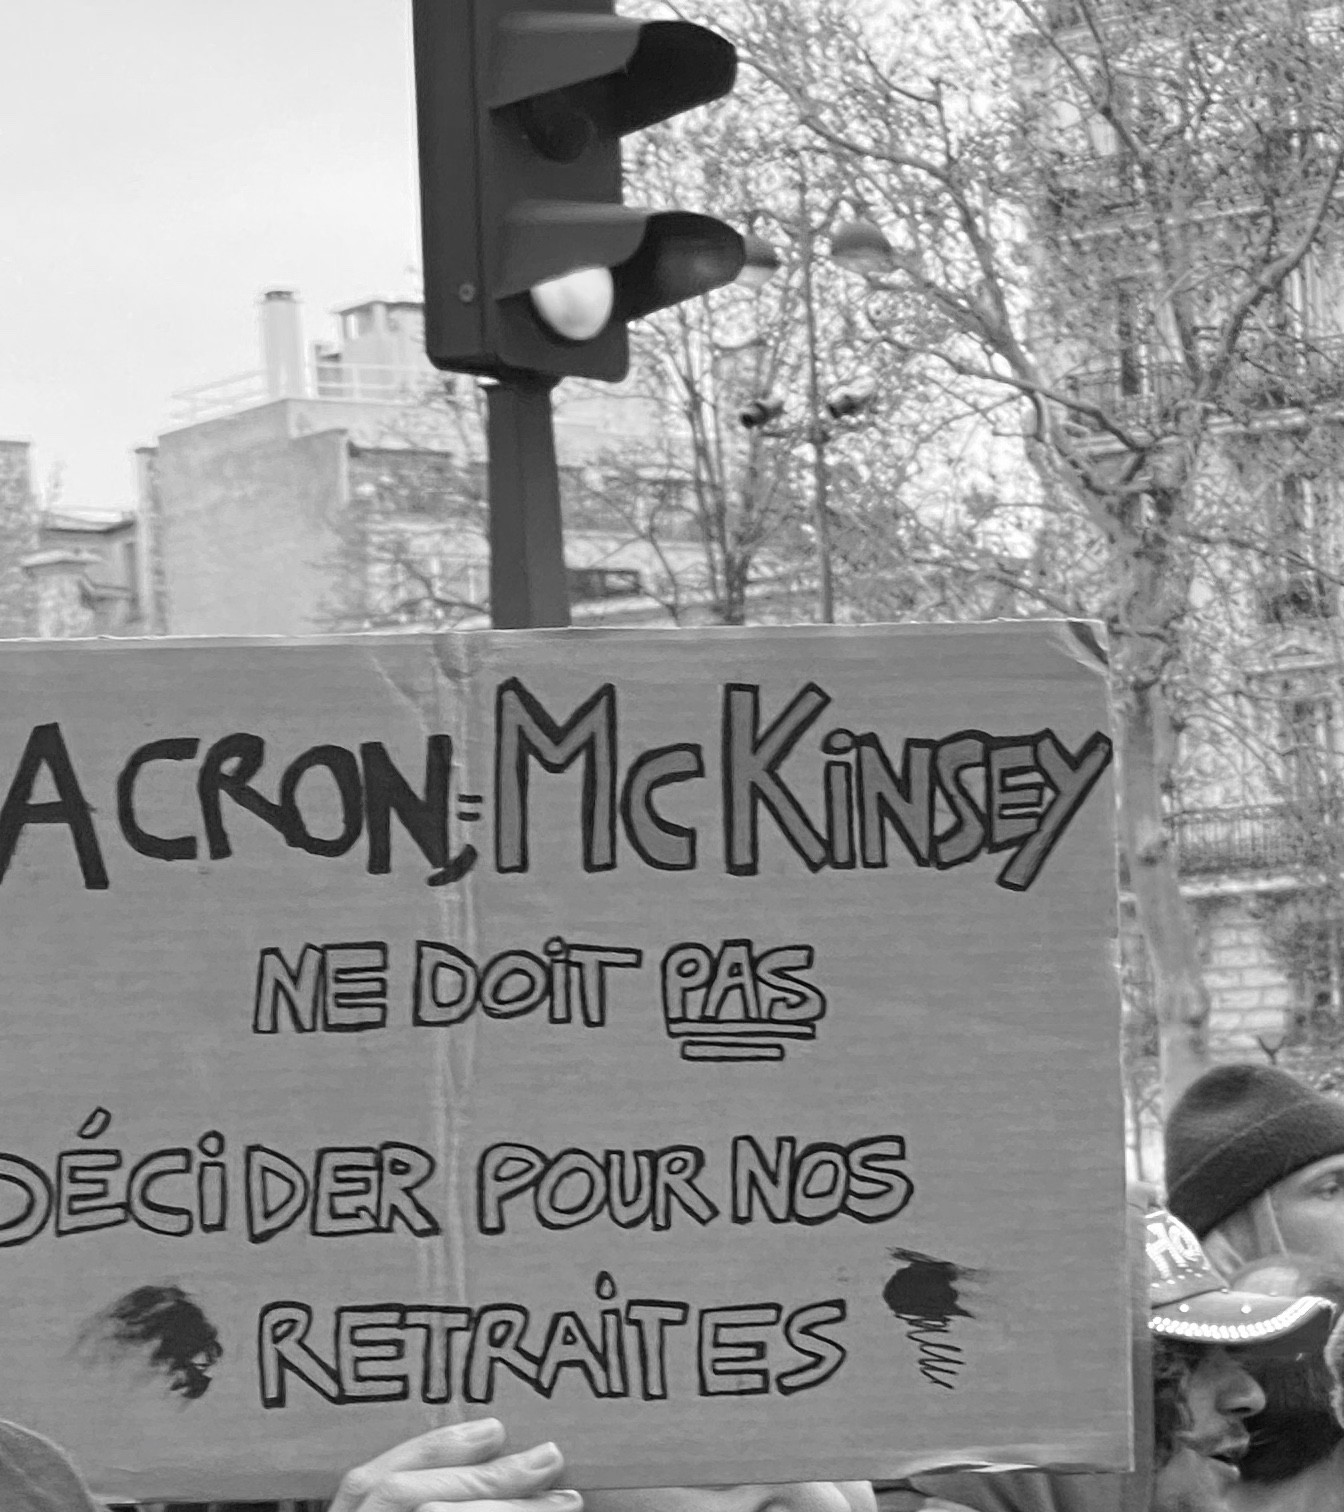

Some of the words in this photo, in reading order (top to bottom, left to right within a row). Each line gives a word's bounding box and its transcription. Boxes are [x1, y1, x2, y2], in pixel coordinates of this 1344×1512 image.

[253, 942, 389, 1034] NE
[661, 939, 826, 1028] PAS
[476, 1142, 720, 1236] POUR
[729, 1136, 915, 1225] NOS
